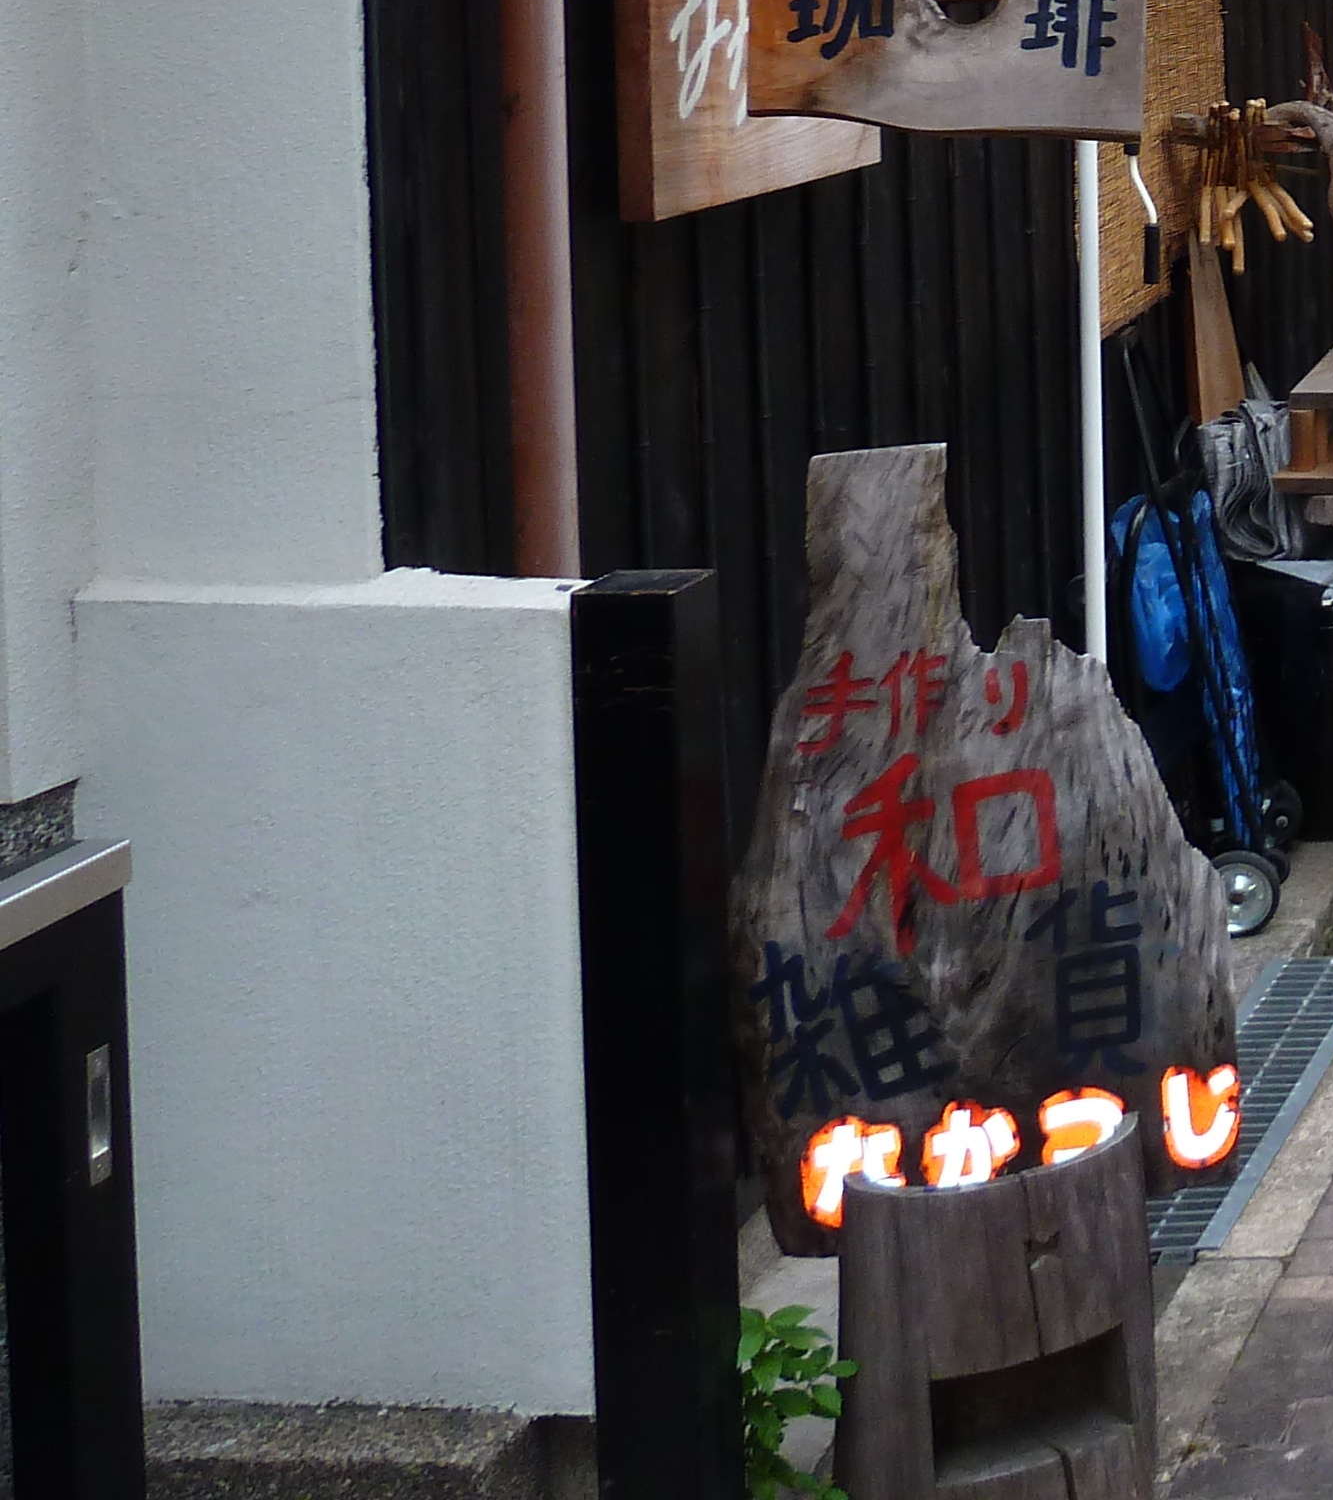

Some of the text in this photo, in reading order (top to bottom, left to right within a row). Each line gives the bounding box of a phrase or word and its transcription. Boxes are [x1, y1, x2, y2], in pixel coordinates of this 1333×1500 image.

[798, 649, 1031, 754] 手作り
[806, 1067, 1240, 1224] なかつじ
